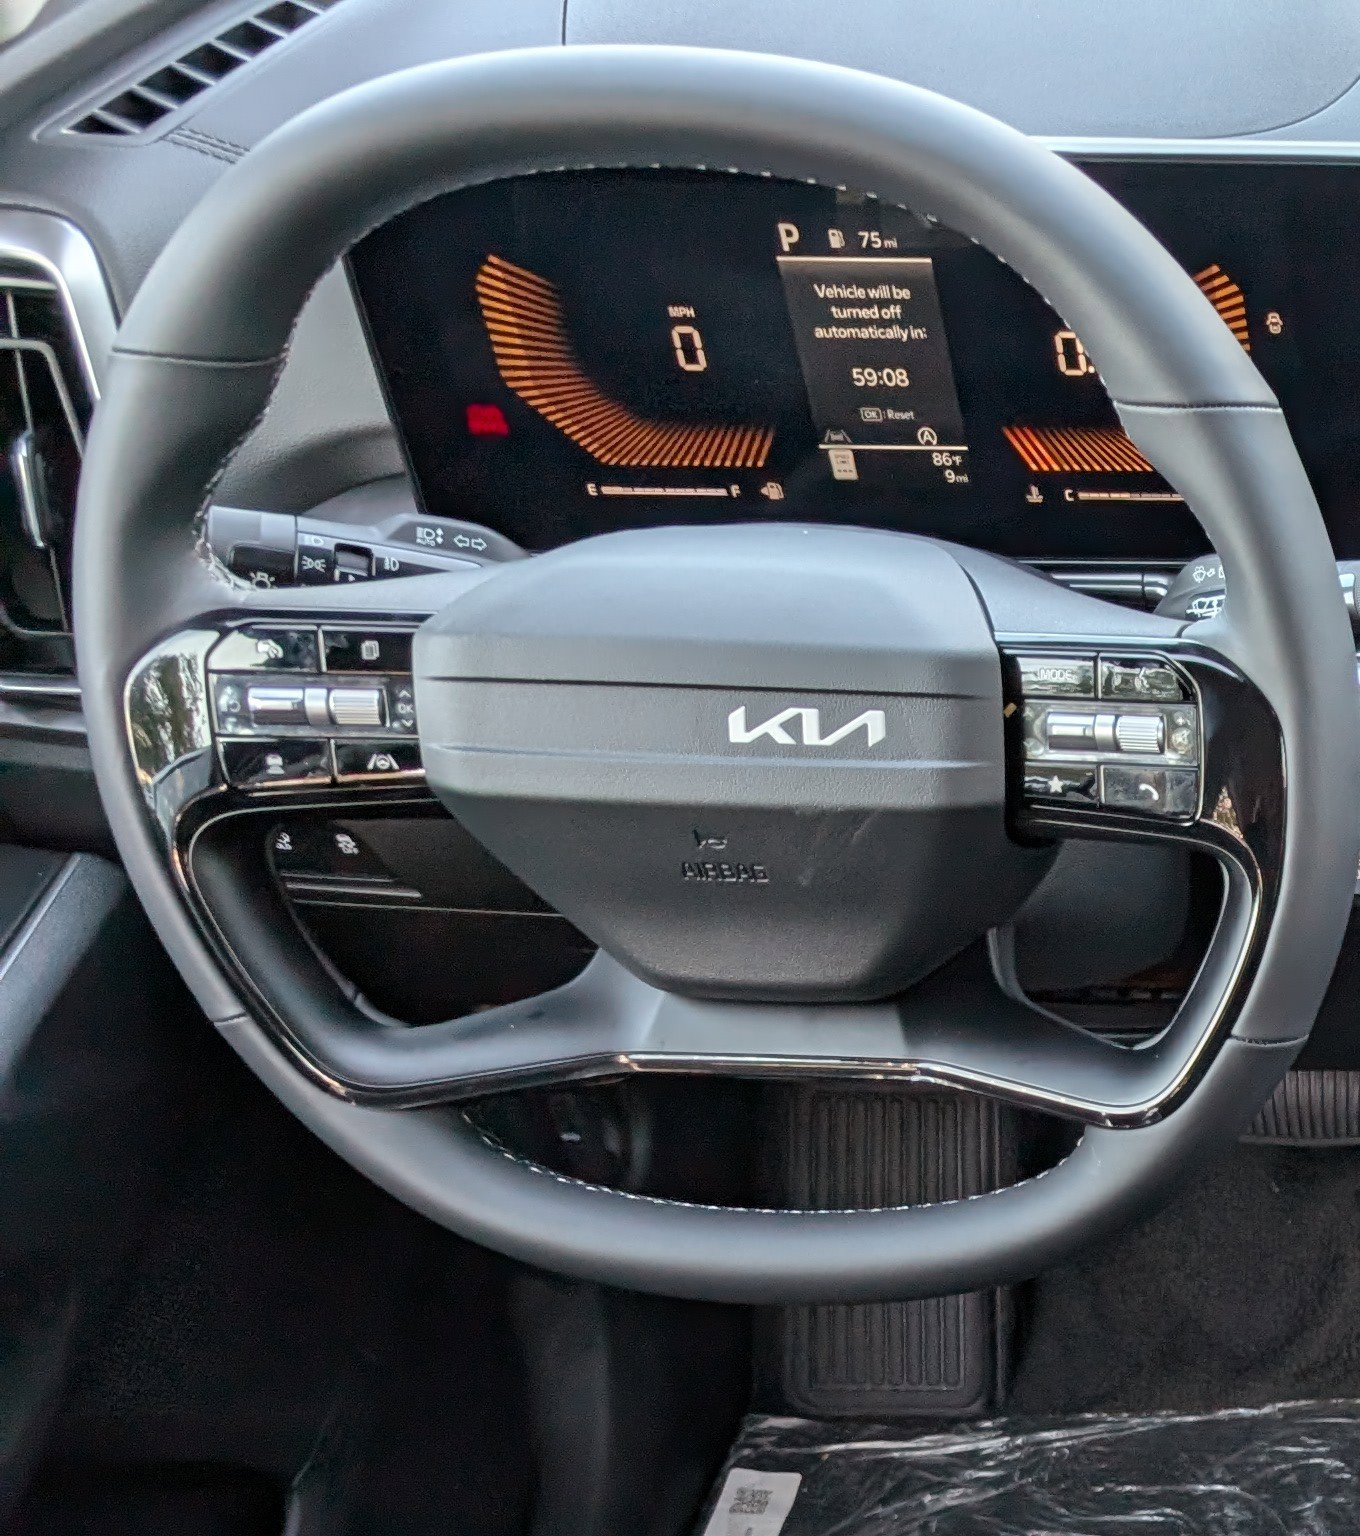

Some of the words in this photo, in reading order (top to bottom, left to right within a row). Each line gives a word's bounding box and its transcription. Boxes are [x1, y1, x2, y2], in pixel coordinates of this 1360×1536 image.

[778, 222, 800, 251] P
[858, 231, 882, 249] 75
[813, 283, 866, 299] Vehicle
[867, 285, 890, 299] will
[892, 285, 911, 300] be
[667, 305, 695, 318] MPH
[831, 305, 879, 319] turned
[881, 305, 901, 320] off
[814, 325, 908, 342] automatically
[910, 326, 927, 340] in:
[671, 325, 708, 371] 0
[852, 367, 910, 387] 59:08
[586, 482, 598, 497] E
[731, 484, 741, 498] F
[1064, 489, 1074, 501] C
[728, 705, 886, 747] KIA
[681, 862, 769, 883] AIRBAG
